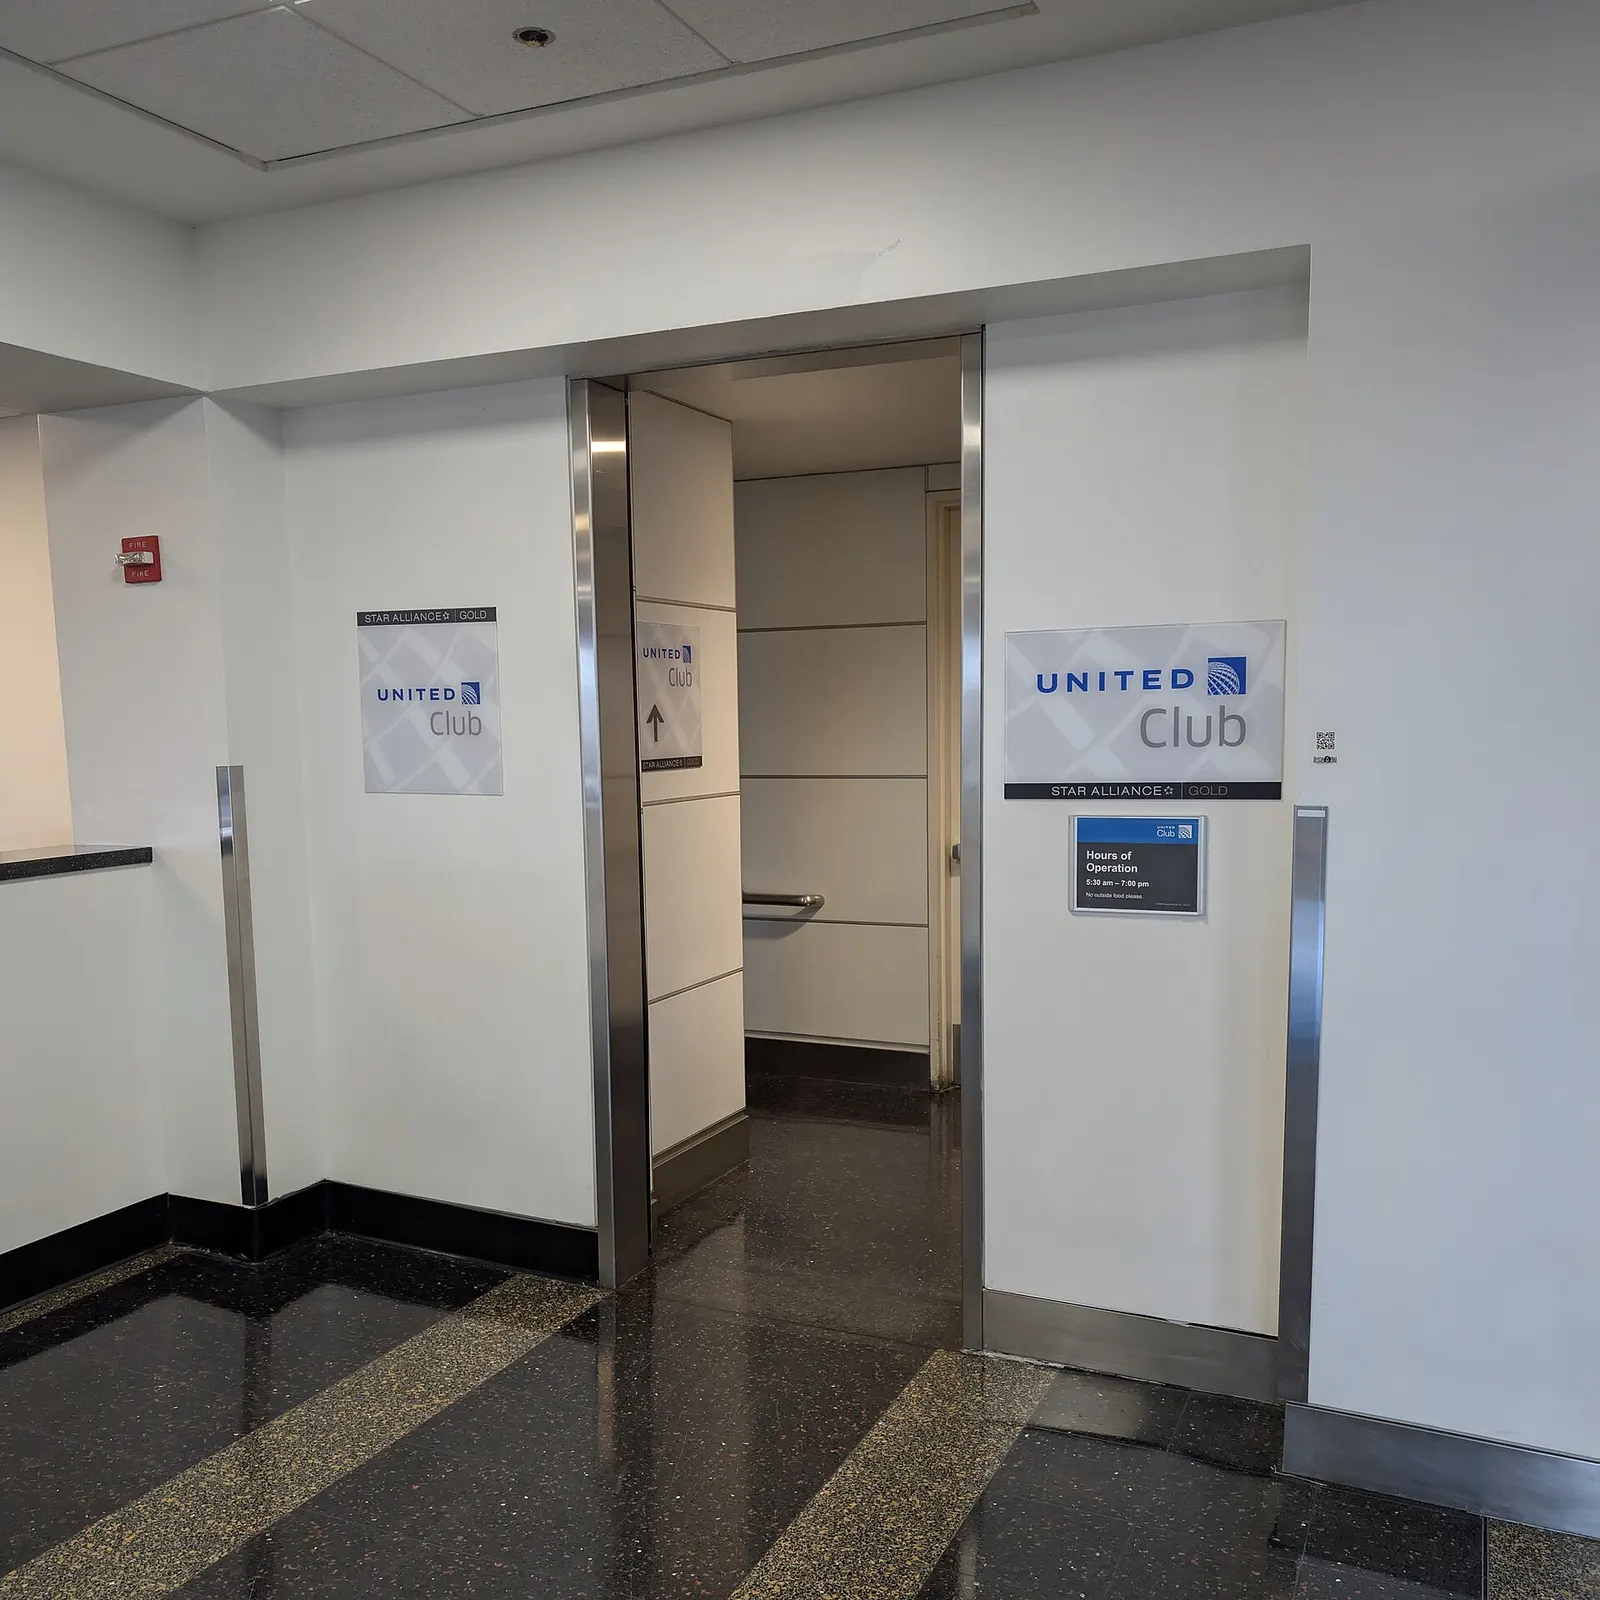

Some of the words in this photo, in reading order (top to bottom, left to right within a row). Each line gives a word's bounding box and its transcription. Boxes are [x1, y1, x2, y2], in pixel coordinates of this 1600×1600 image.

[129, 541, 147, 549] FIRE
[131, 569, 149, 577] FIRE
[364, 613, 390, 624] STAR
[392, 611, 442, 622] ALLIANCE
[459, 610, 487, 620] GOLD
[643, 647, 681, 660] UNITED
[668, 667, 693, 687] Club
[1037, 668, 1195, 694] UNITED
[377, 687, 456, 701] UNITED
[429, 710, 482, 736] Club
[1140, 705, 1247, 748] Club
[642, 761, 656, 770] STAR
[656, 759, 680, 769] ALLIANCE
[1051, 786, 1087, 797] STAR
[1090, 785, 1163, 797] ALLIANCE
[1188, 785, 1229, 796] GOLD
[1156, 829, 1176, 838] Club
[1086, 850, 1118, 860] Hours
[1120, 851, 1133, 861] of
[1086, 862, 1138, 874] Operation
[1085, 878, 1101, 886] 5:30
[1121, 879, 1136, 888] 7:00
[1137, 881, 1150, 889] pm
